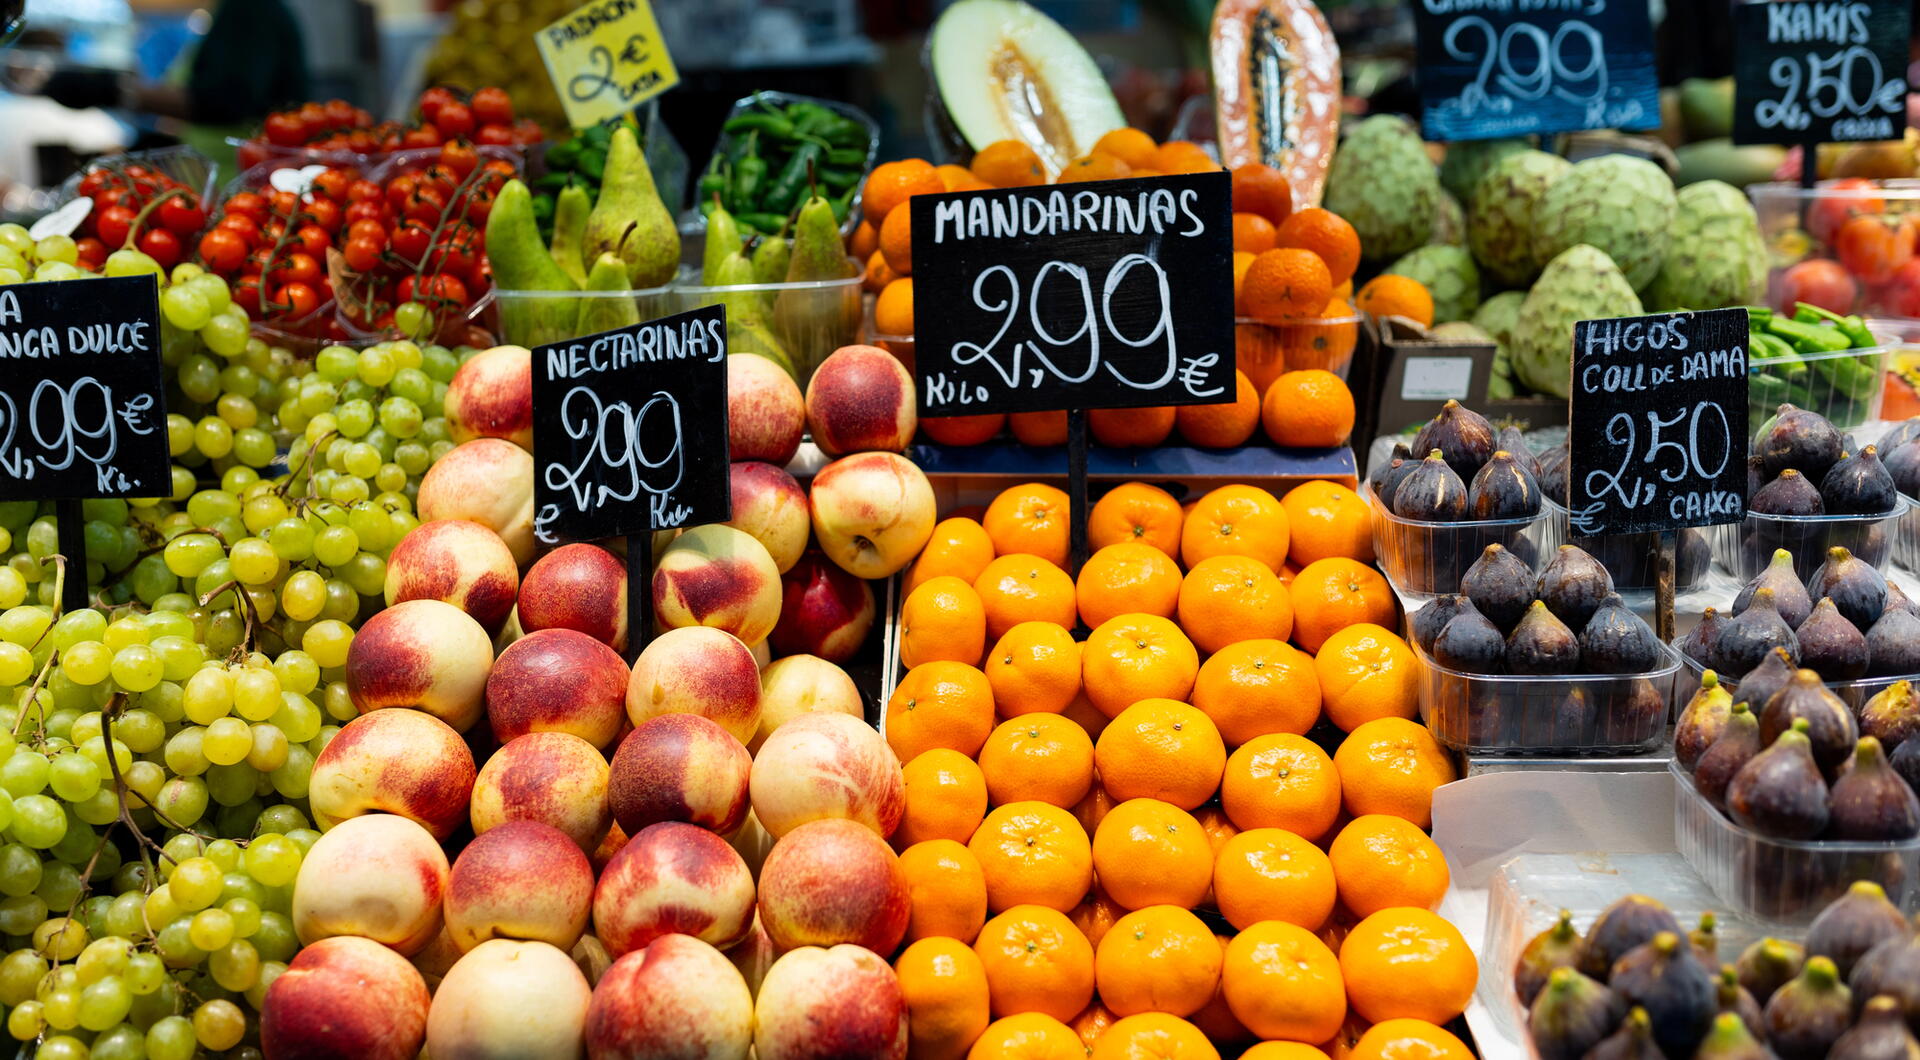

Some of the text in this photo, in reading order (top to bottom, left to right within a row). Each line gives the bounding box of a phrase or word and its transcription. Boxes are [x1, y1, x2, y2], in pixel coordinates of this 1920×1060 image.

[568, 34, 648, 102] 2 €
[934, 188, 1205, 244] MANDARINAS
[547, 319, 724, 381] NECTARINAS
[1585, 317, 1689, 356] HIGOS
[1582, 345, 1746, 394] COLL DE DAMA
[545, 385, 684, 512] 2,99
[1585, 400, 1731, 510] 2,50
[534, 503, 561, 544] €
[1569, 490, 1743, 535] € CAIXA
